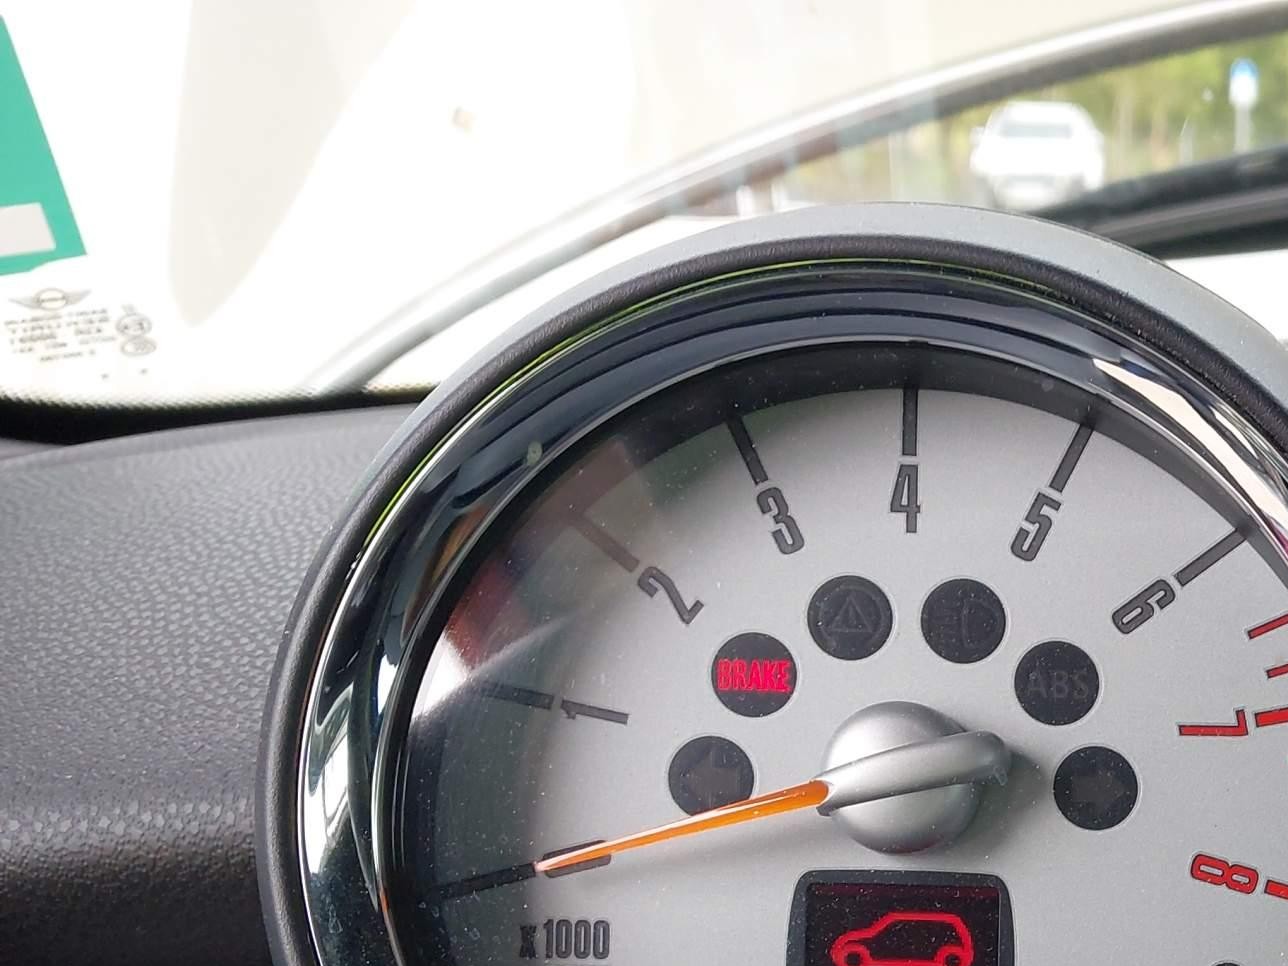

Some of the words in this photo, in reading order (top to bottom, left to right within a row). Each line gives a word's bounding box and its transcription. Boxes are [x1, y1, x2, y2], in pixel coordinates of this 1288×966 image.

[757, 487, 805, 555] 3
[891, 464, 920, 533] 4
[1011, 492, 1061, 562] 5
[638, 566, 704, 625] 2
[1112, 579, 1175, 634] 6
[717, 658, 792, 692] BRAKE
[1026, 669, 1089, 699] ABS
[560, 700, 629, 725] 1
[1178, 709, 1248, 736] 7
[1191, 854, 1258, 894] 8
